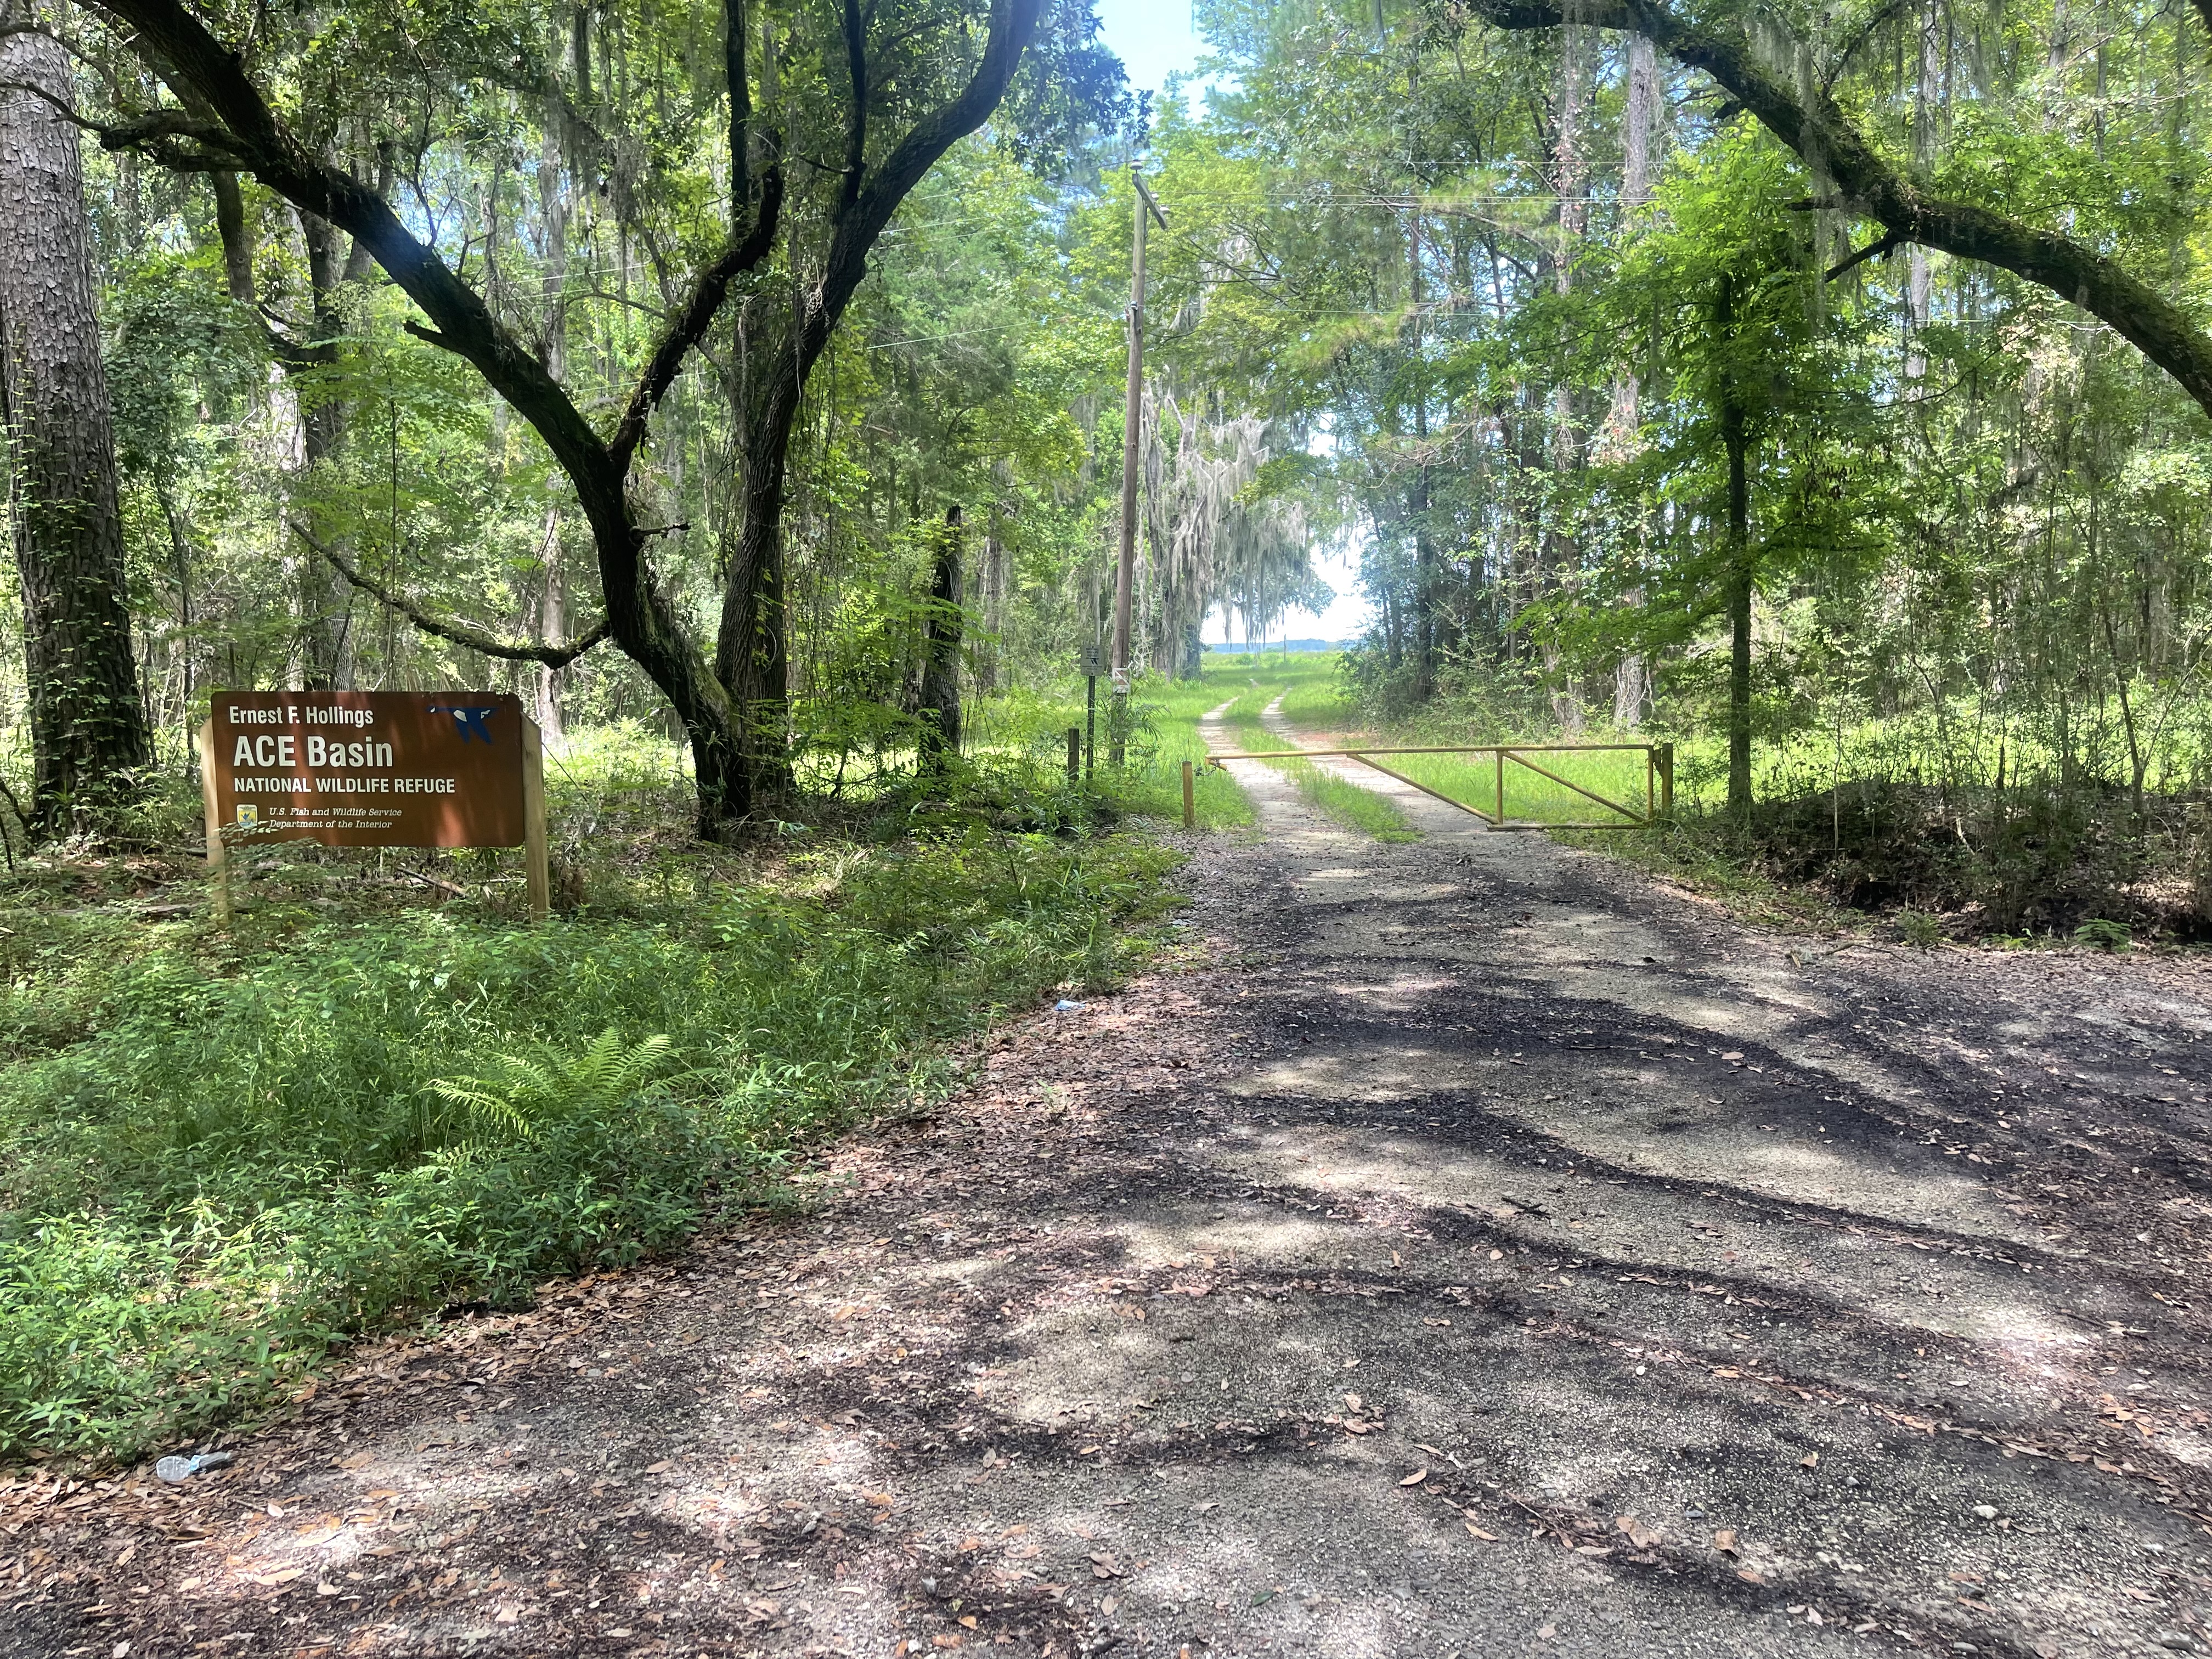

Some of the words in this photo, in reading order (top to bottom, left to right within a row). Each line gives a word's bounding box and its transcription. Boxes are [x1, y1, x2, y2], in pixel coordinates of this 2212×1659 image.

[229, 706, 283, 724] Ernest
[288, 706, 300, 724] F.
[306, 706, 374, 728] Hollings
[234, 735, 296, 767] ACE
[307, 736, 393, 768] Basin
[234, 777, 312, 793] NATIONAL
[316, 778, 389, 793] WILDLIFE
[394, 778, 455, 793] REFUGE
[269, 807, 287, 816] U.S.
[290, 808, 309, 816] Fish
[332, 808, 366, 816] Wildlife
[368, 808, 402, 816] Service
[269, 819, 323, 829] Department
[338, 820, 353, 828] the
[355, 820, 392, 828] Interior
